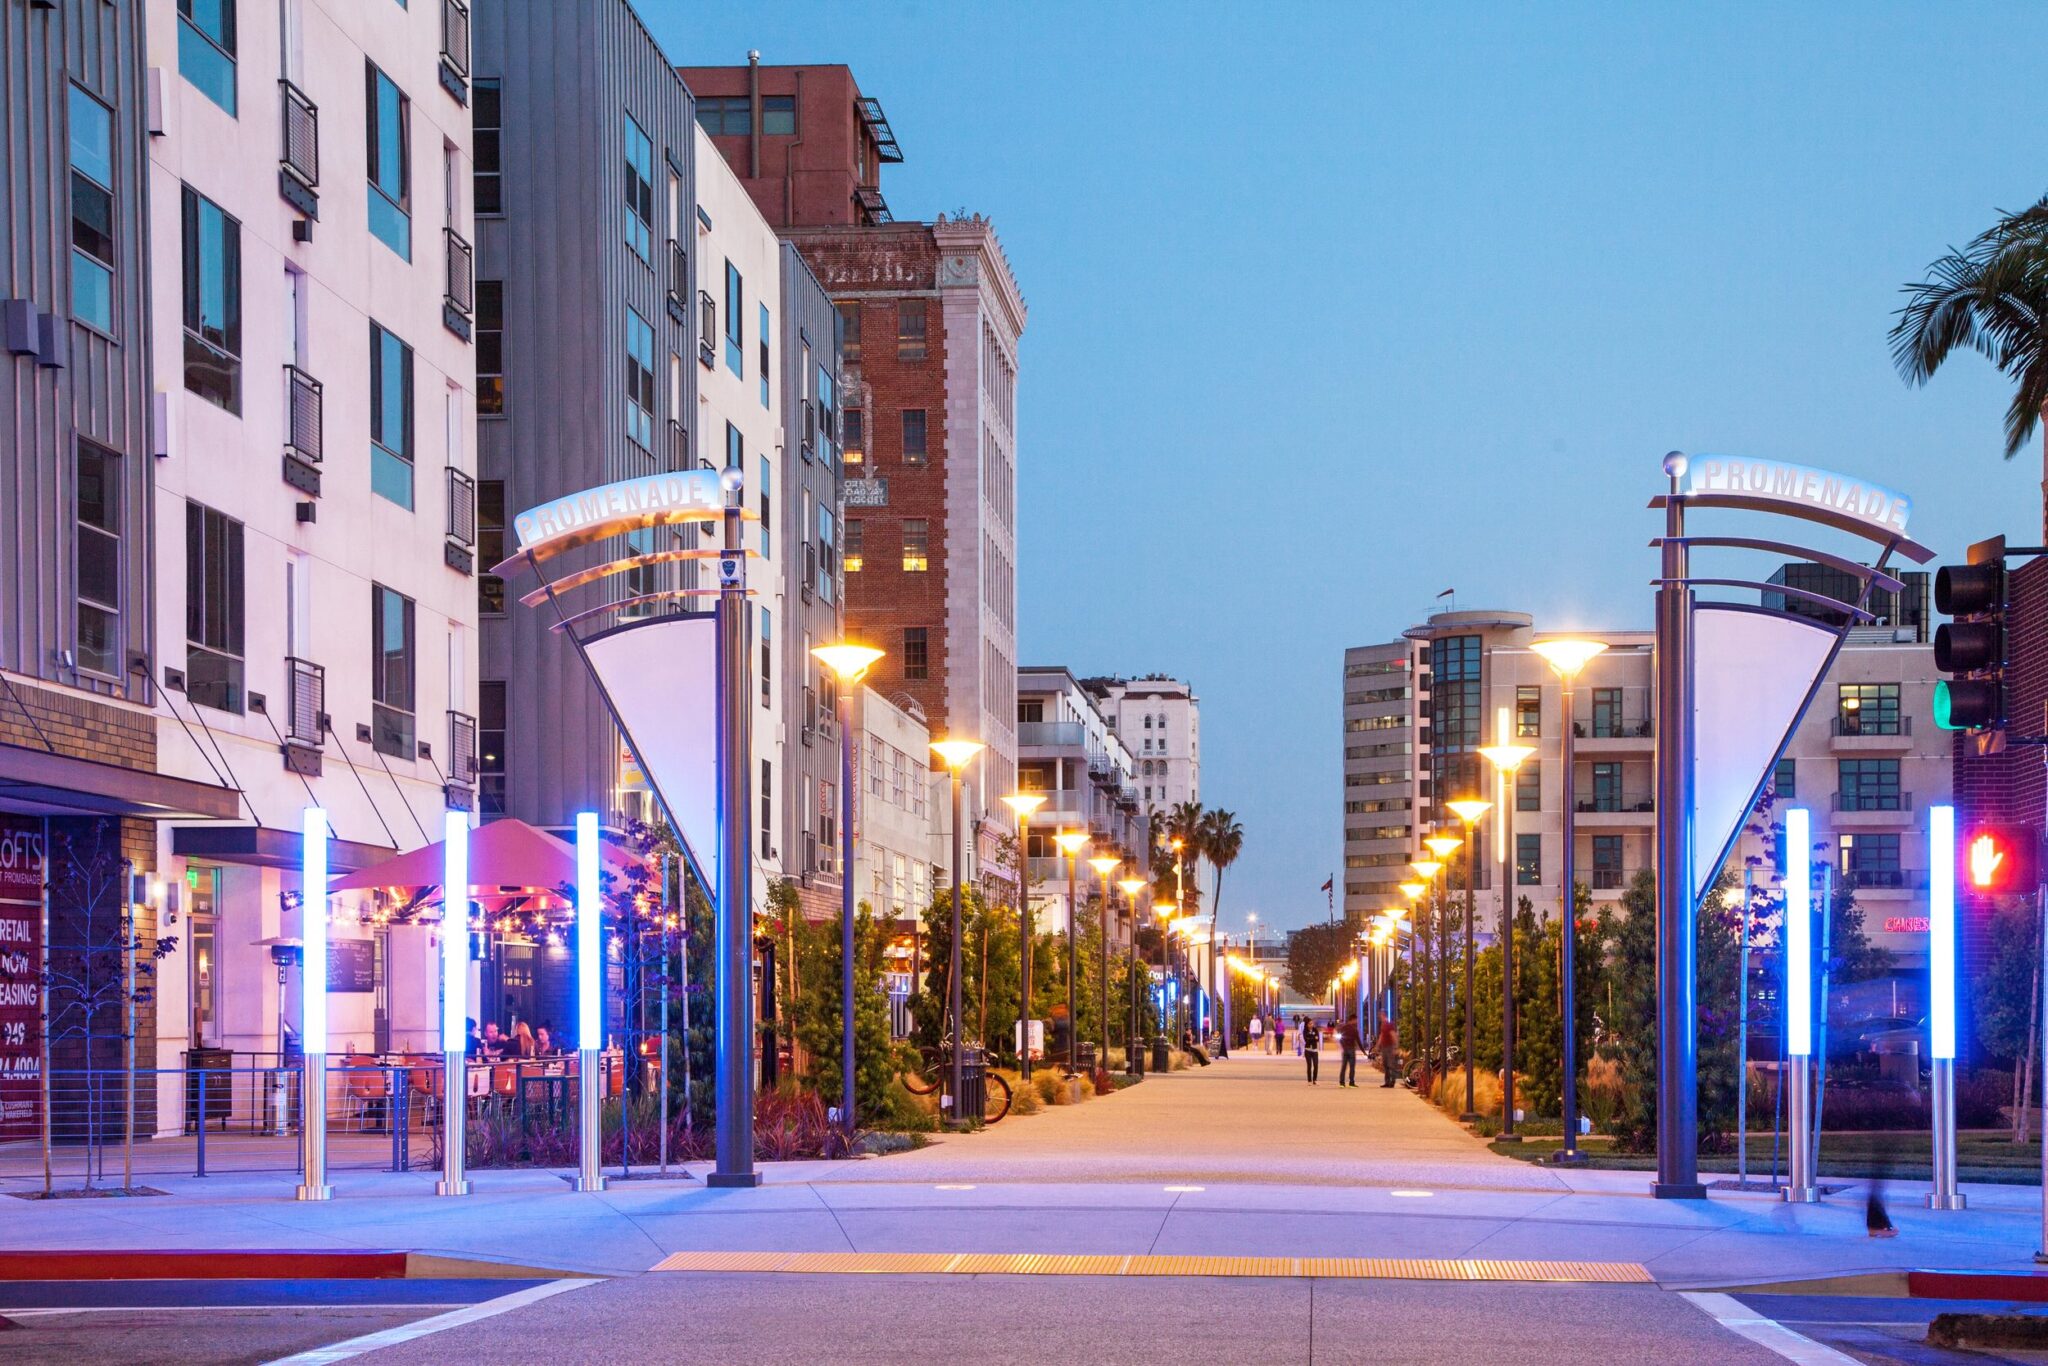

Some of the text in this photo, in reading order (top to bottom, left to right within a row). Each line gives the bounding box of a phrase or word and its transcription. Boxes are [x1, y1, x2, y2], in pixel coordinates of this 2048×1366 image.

[1704, 460, 1908, 529] PROMENADE
[517, 475, 703, 544] PROMENADE
[4, 872, 41, 885] PROMENADE
[0, 919, 31, 942] RETAIL
[1885, 917, 1931, 932] CHINES
[2, 953, 29, 974] NOW
[0, 984, 37, 1006] EASING
